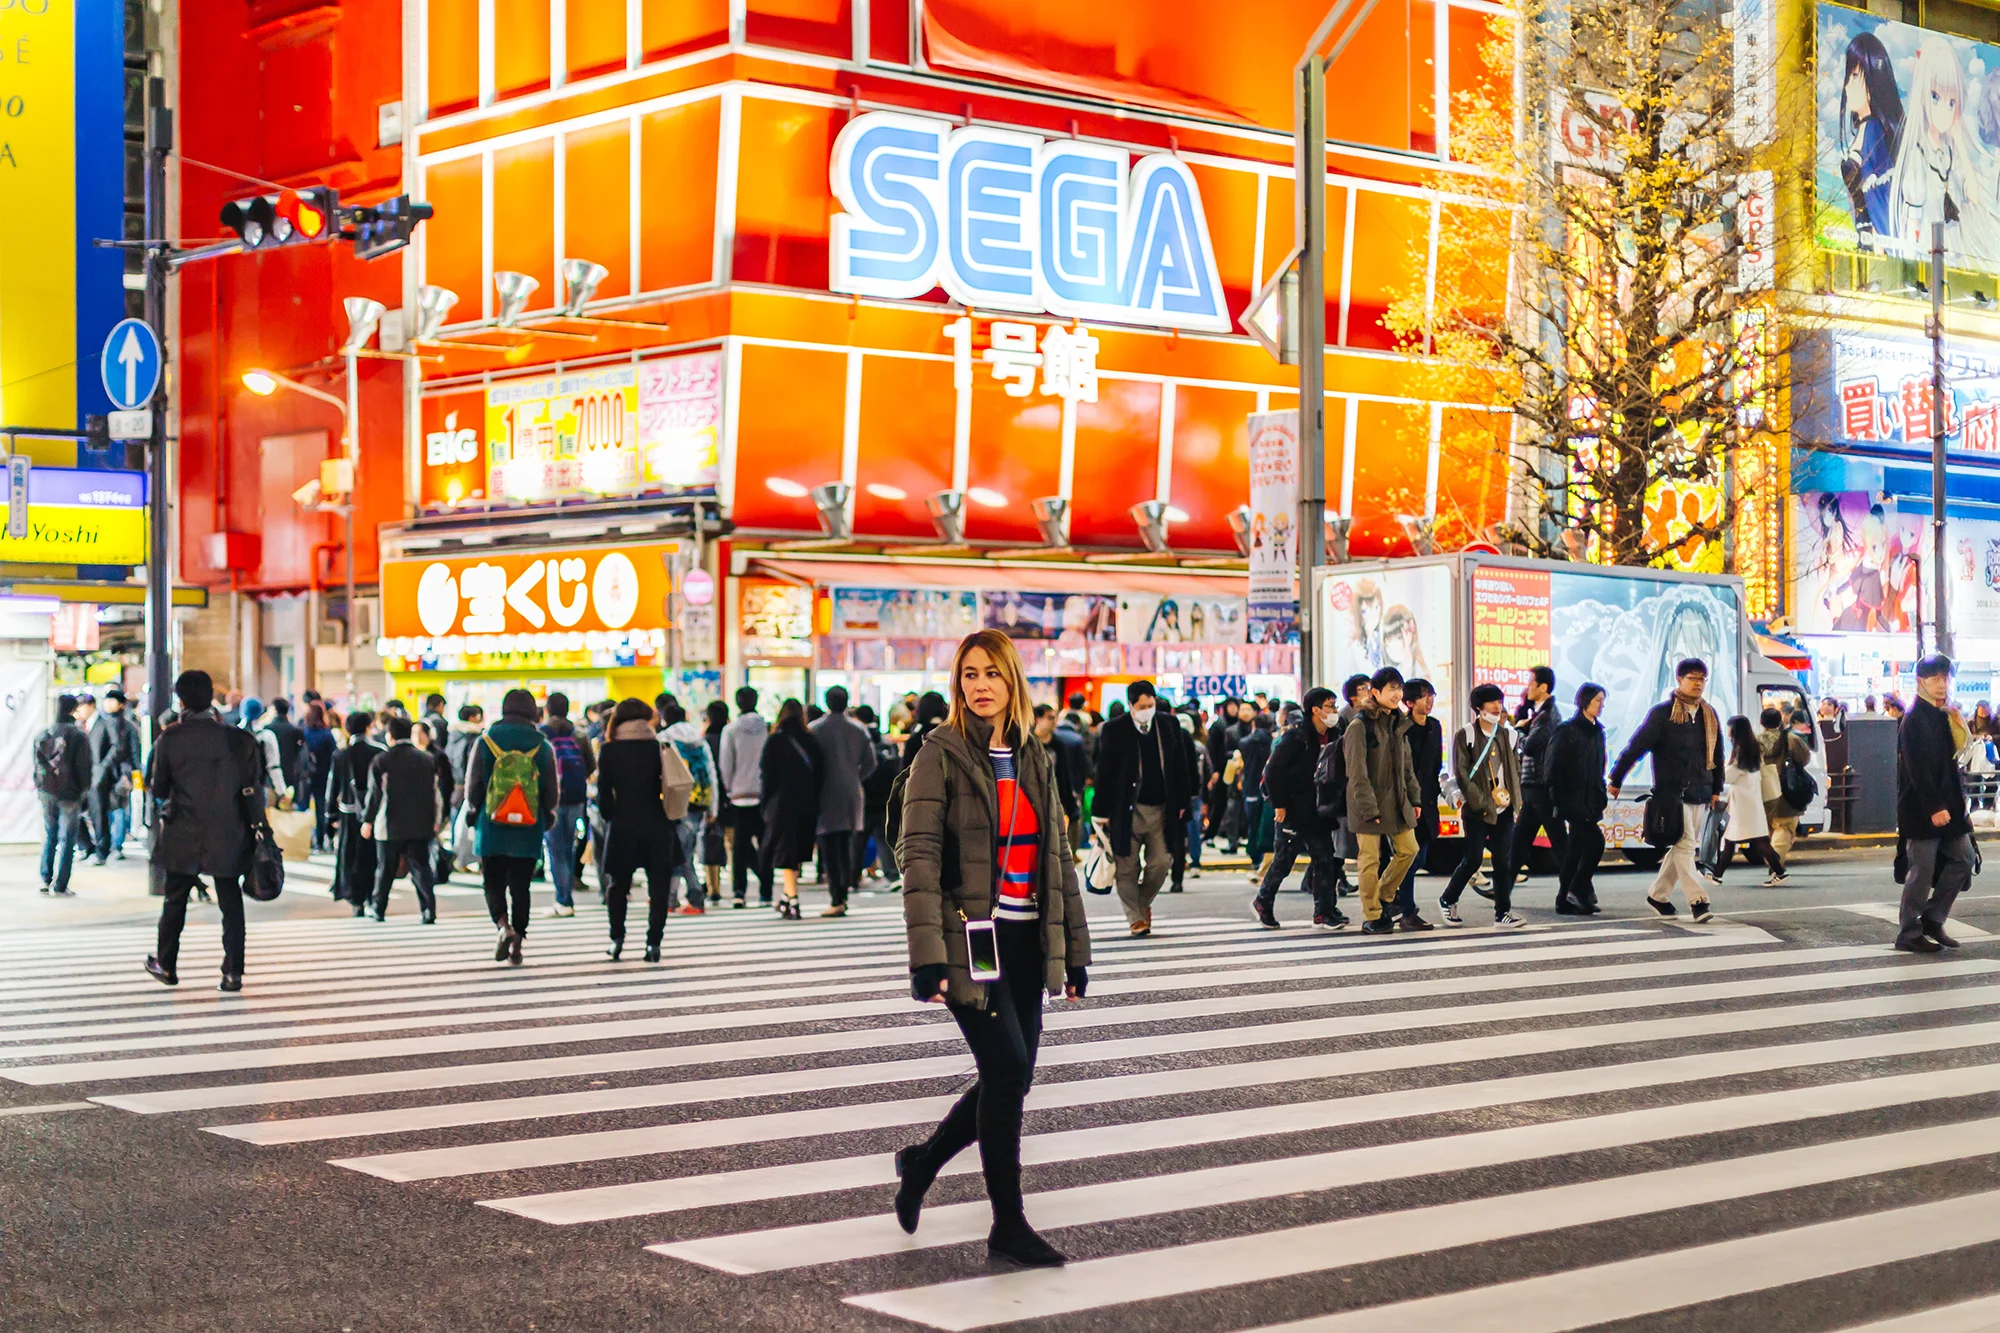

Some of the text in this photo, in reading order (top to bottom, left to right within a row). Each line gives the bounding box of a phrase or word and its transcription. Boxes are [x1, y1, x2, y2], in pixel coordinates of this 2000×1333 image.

[831, 112, 1230, 331] SEGA
[942, 317, 1099, 402] 1号館
[427, 428, 478, 466] BIG
[33, 523, 100, 544] Yoshi
[460, 558, 588, 633] 宝くじ
[1475, 604, 1548, 626] アールジュネス
[1475, 623, 1535, 646] 秋葉原にて
[1184, 676, 1246, 696] FGOくじ
